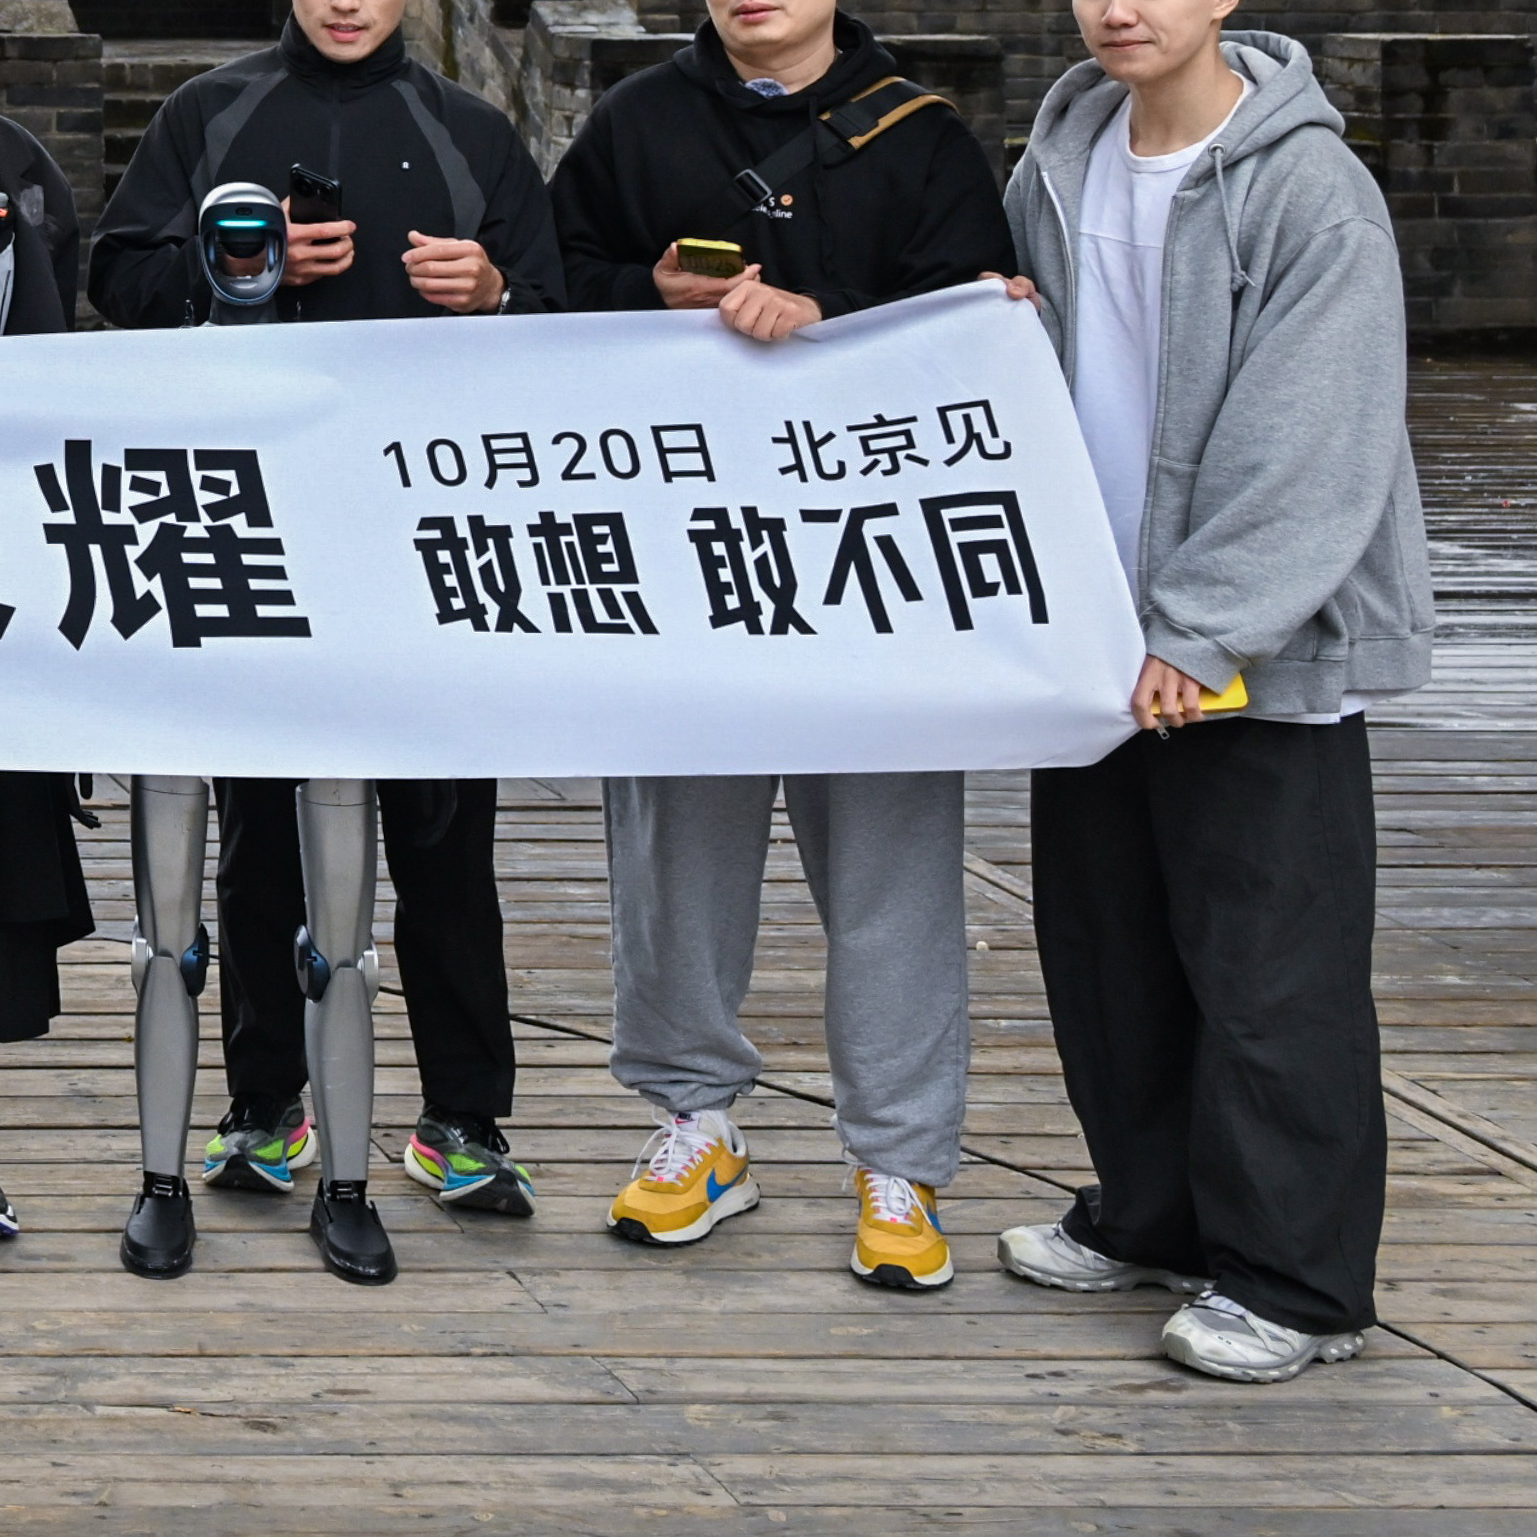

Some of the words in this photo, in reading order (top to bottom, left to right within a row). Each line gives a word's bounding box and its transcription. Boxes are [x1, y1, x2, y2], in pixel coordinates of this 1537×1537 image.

[381, 422, 717, 490] 10月20日
[771, 398, 1013, 484] 北京见
[412, 510, 661, 636] 敢想
[686, 489, 1050, 636] 敢不同
